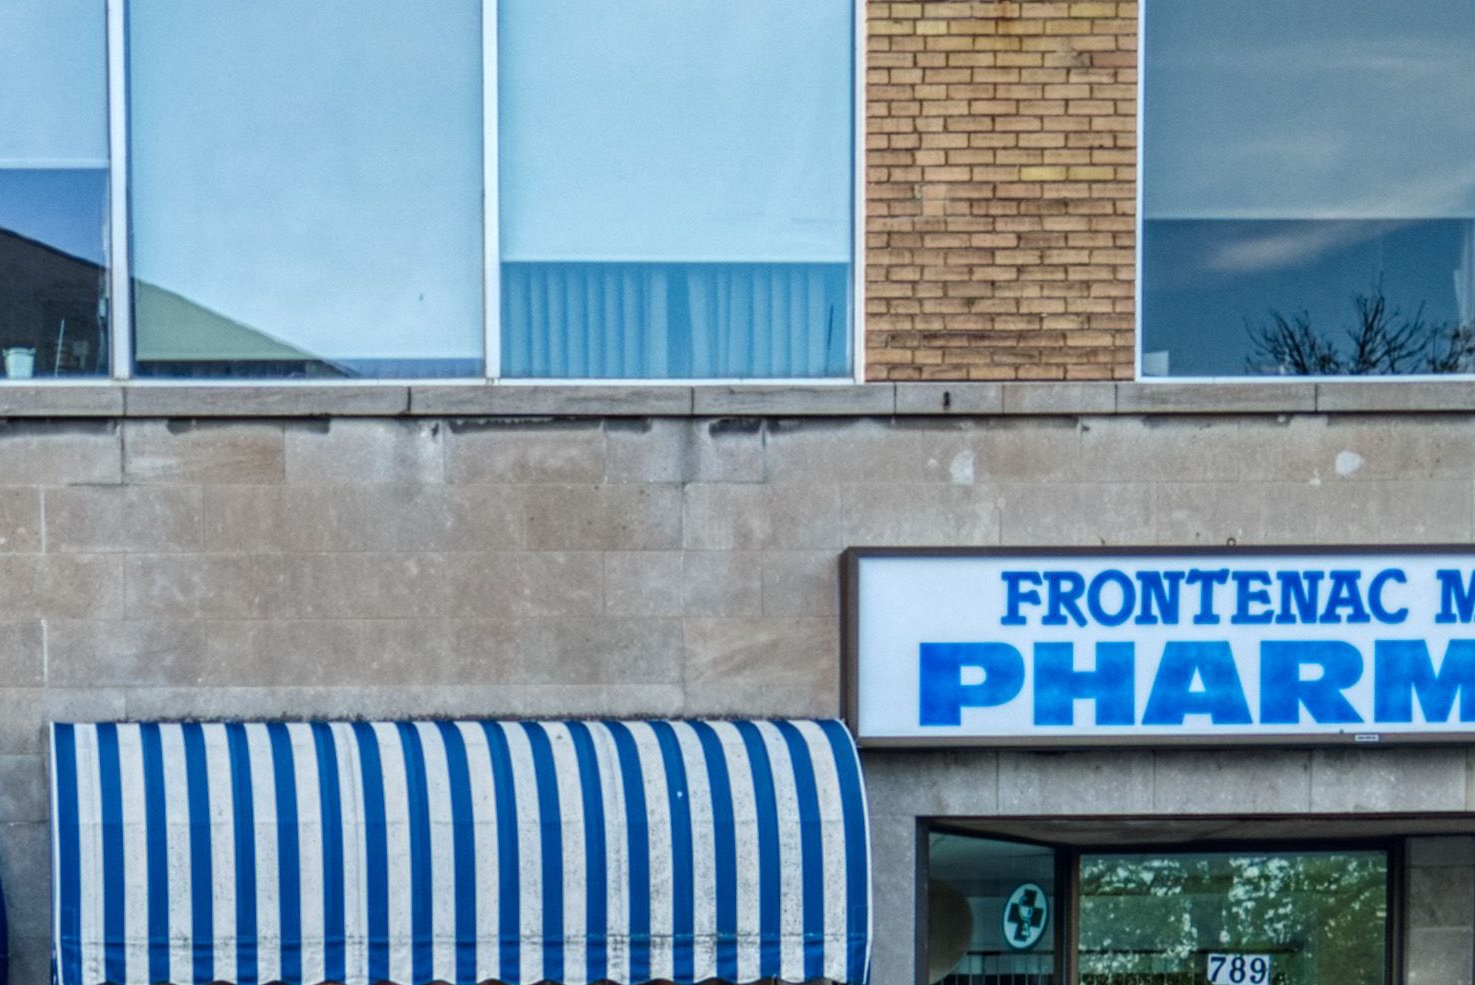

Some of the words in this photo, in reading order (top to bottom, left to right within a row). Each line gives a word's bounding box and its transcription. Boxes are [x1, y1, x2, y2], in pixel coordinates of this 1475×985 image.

[1000, 568, 1409, 627] FRONTENAC
[918, 638, 1475, 727] PHARM
[1210, 956, 1266, 985] 789
